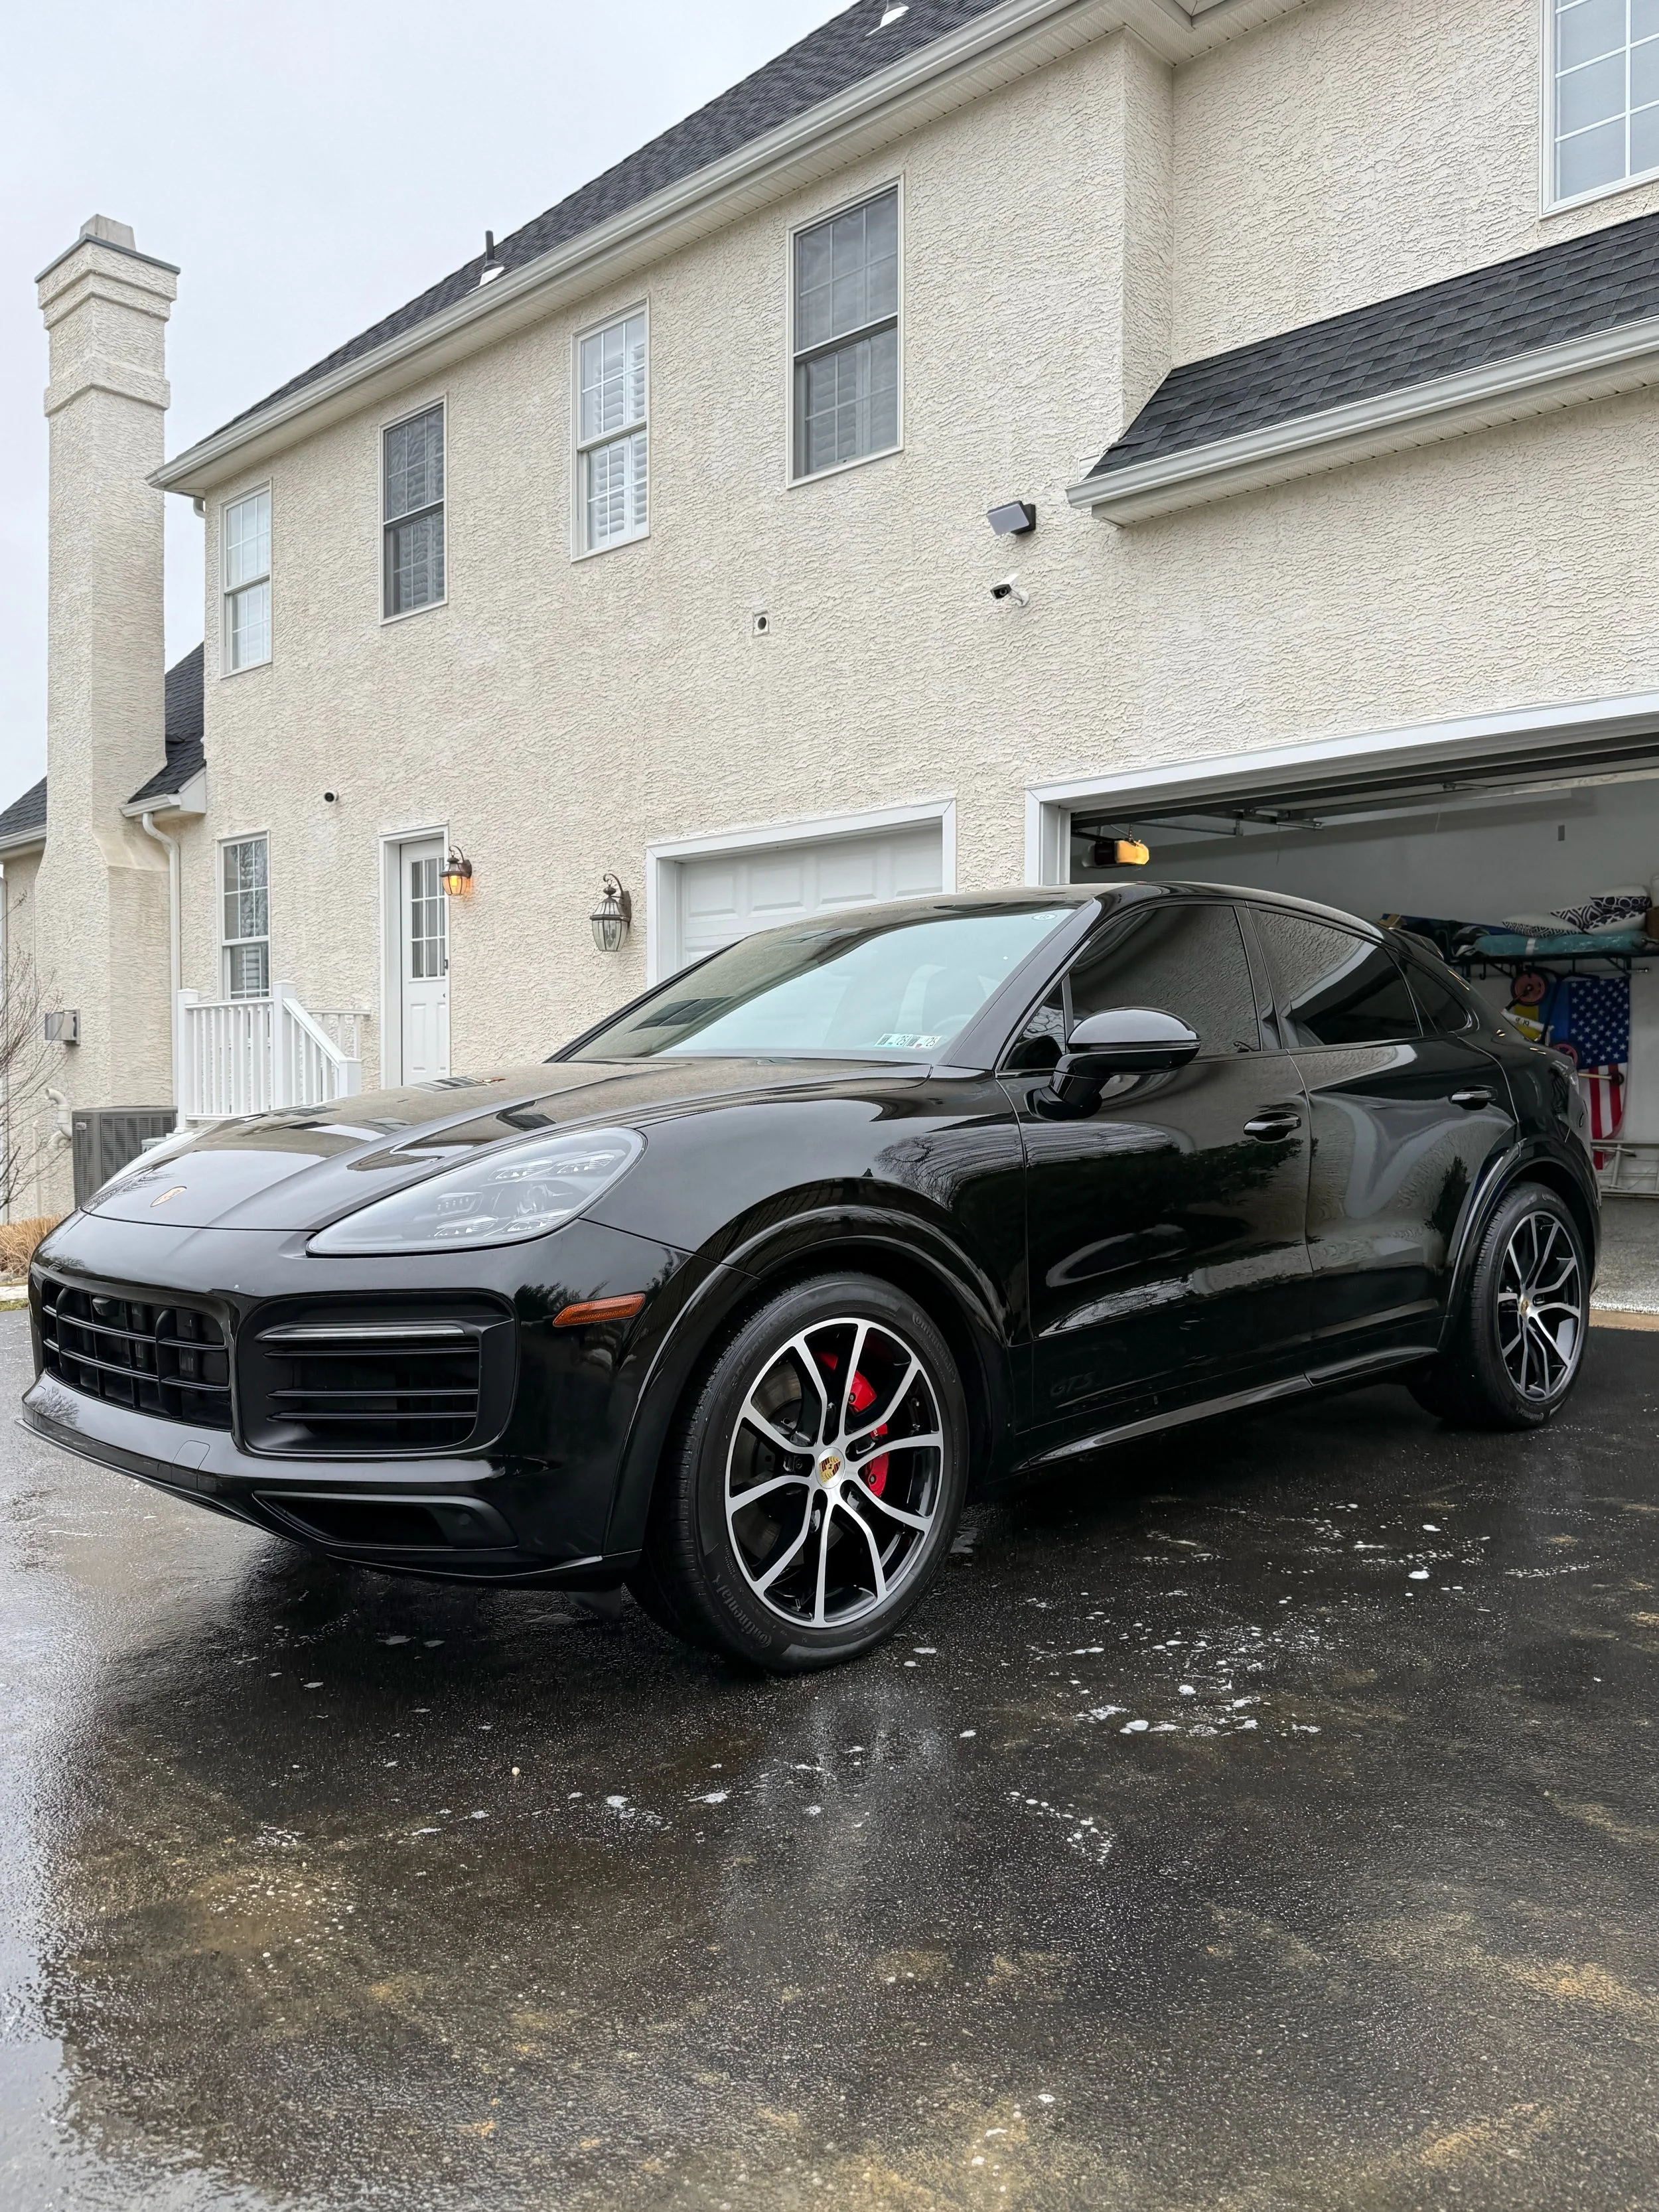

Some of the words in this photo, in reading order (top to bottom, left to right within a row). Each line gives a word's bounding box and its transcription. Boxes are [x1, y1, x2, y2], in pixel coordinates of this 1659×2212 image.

[926, 1037, 938, 1047] 25
[1050, 1370, 1096, 1397] GTS
[715, 1584, 772, 1649] Continental
